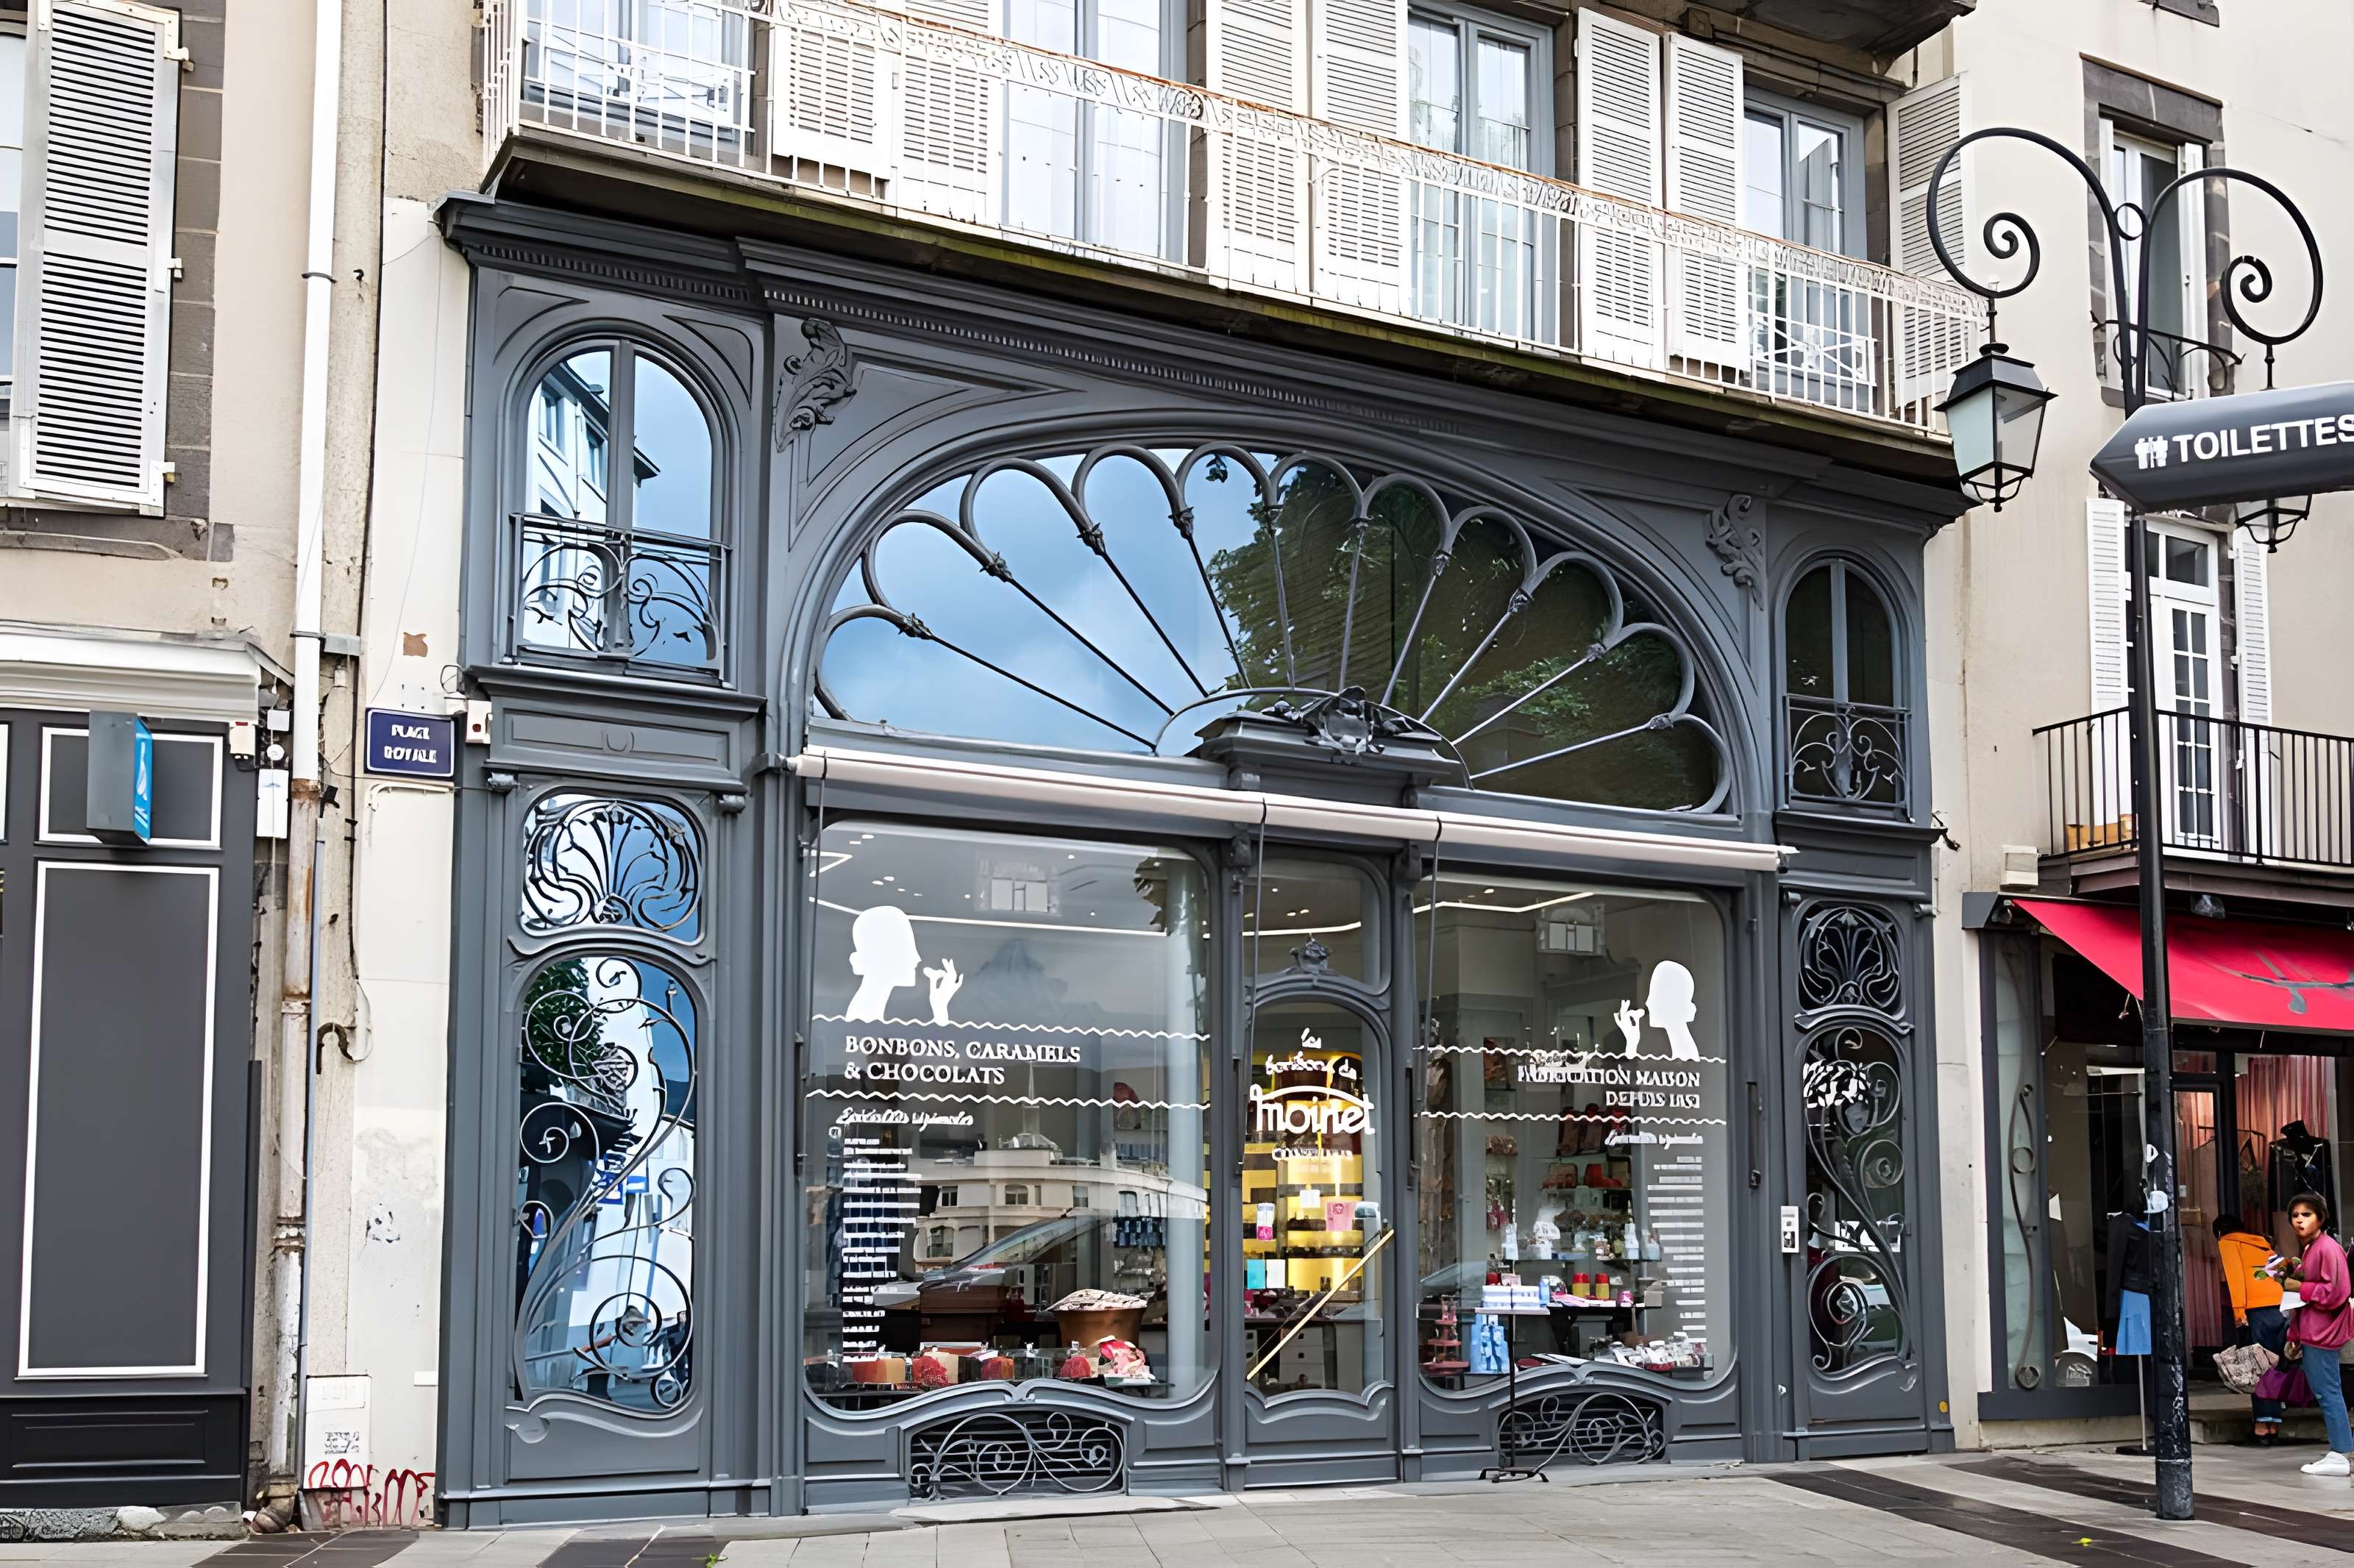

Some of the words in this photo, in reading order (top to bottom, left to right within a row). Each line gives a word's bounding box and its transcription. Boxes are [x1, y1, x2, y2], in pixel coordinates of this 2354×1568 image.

[2172, 413, 2354, 463] TOILETTES
[845, 1036, 960, 1060] BONBONS,
[844, 1061, 861, 1080] &
[867, 1063, 1005, 1085] CHOCOLATS
